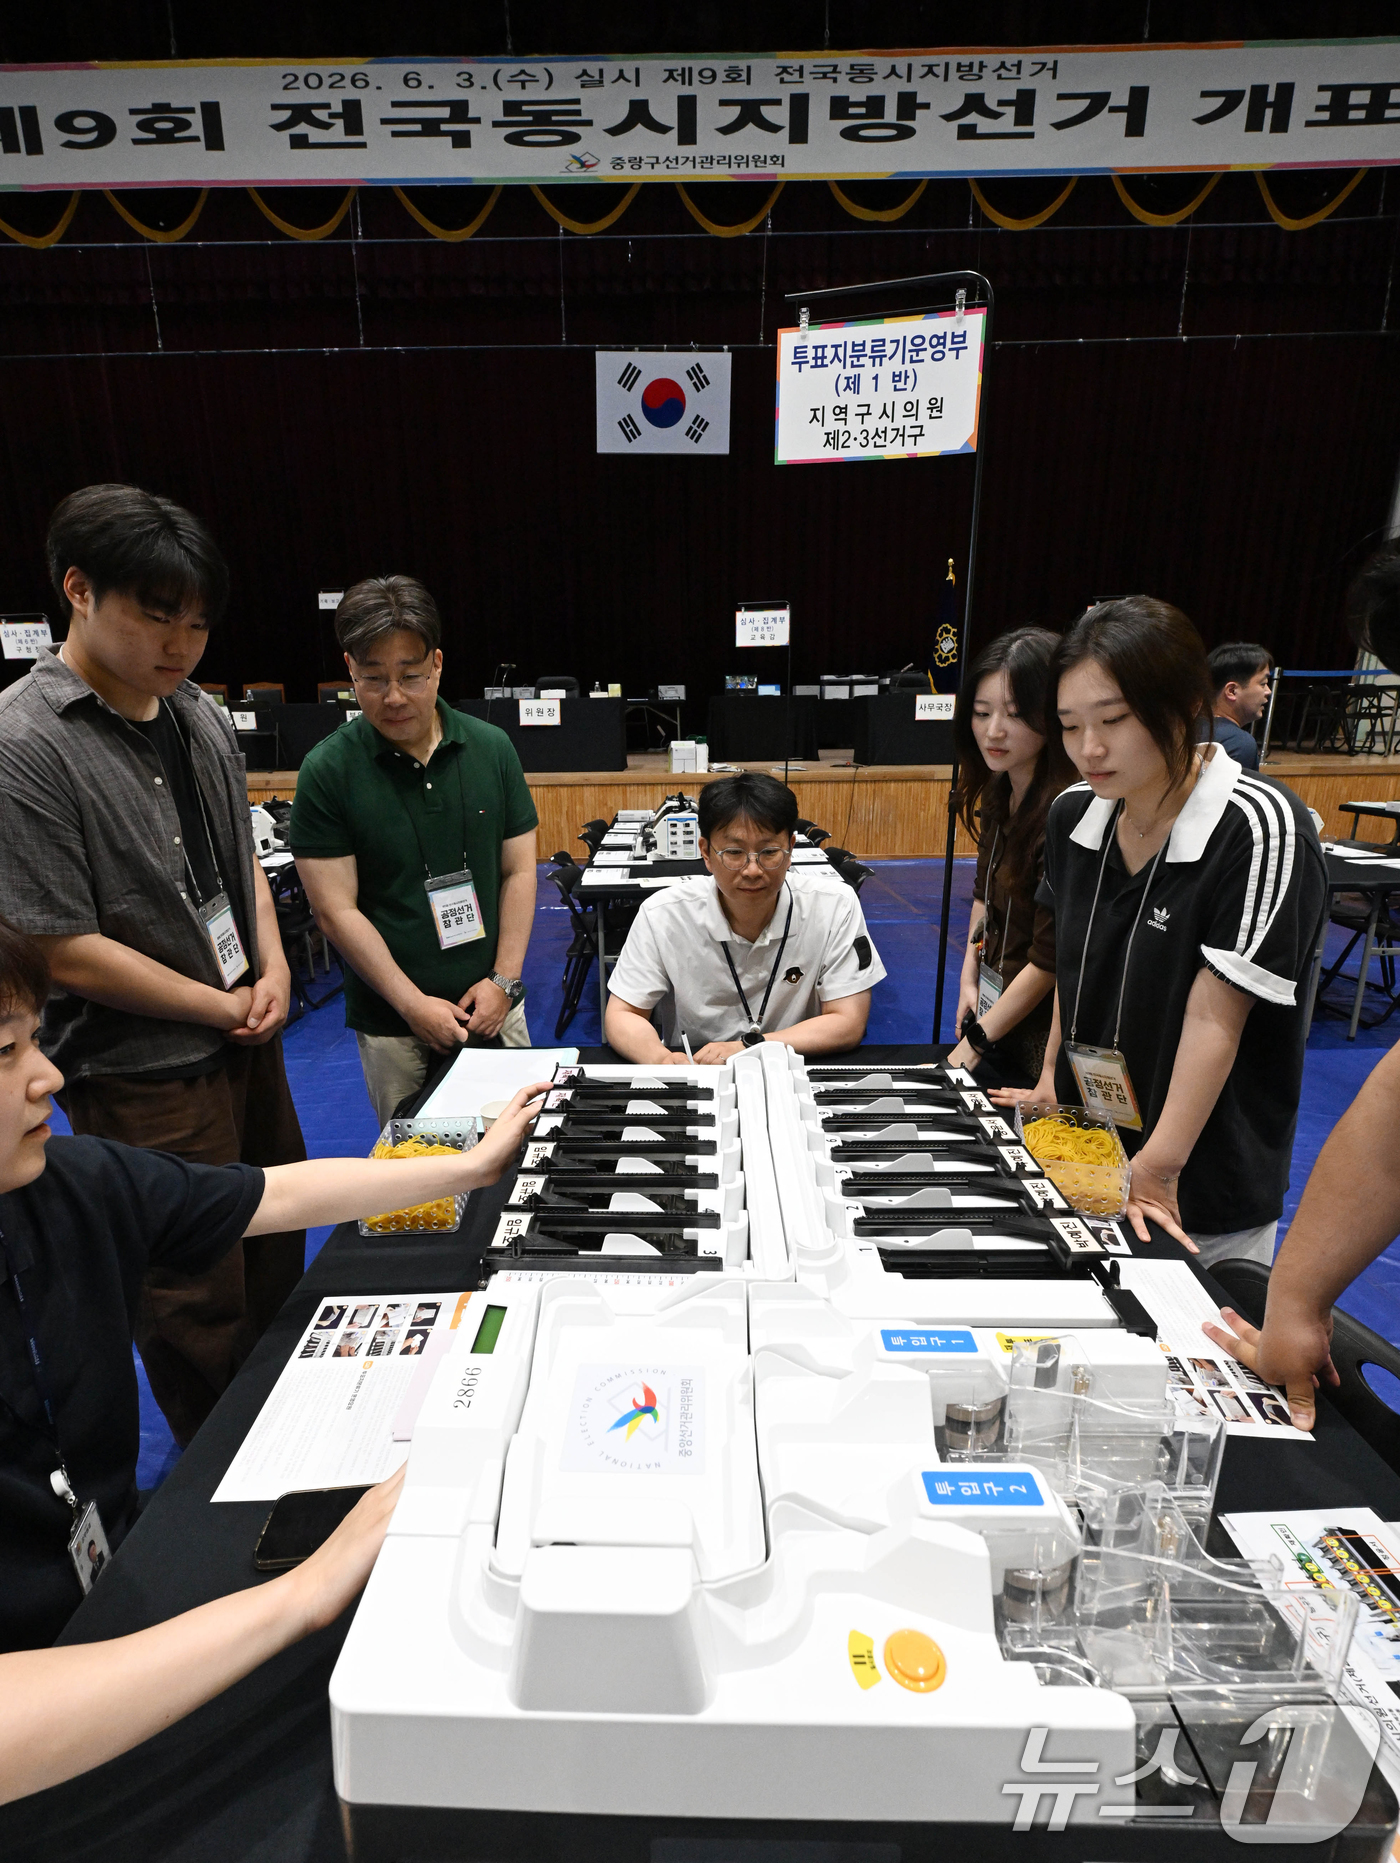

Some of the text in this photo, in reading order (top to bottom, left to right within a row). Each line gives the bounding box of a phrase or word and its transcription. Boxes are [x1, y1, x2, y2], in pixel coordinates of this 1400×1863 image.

[281, 60, 1060, 91] 2026. 6. 3.(수) 실시 제9회 전국동시지방선거
[268, 86, 1150, 149] 전국동시지방선거
[609, 153, 786, 171] 중랑구선거관리위원회
[791, 329, 968, 373] 투표지분류기운영부
[823, 424, 925, 451] 제2·3선거구
[919, 703, 952, 712] 사무국장
[441, 904, 473, 919] 공정선거
[1147, 919, 1167, 931] adidas
[1084, 1077, 1124, 1094] 공정선거
[891, 1336, 947, 1347] 투입구
[453, 1367, 482, 1409] 2866
[594, 1368, 667, 1392] COMMISSION
[580, 1397, 594, 1447] ELECTION
[678, 1378, 694, 1458] 중앙선거관리위원회
[598, 1450, 661, 1470] NATIONAL
[935, 1481, 1027, 1496] 투입구 2
